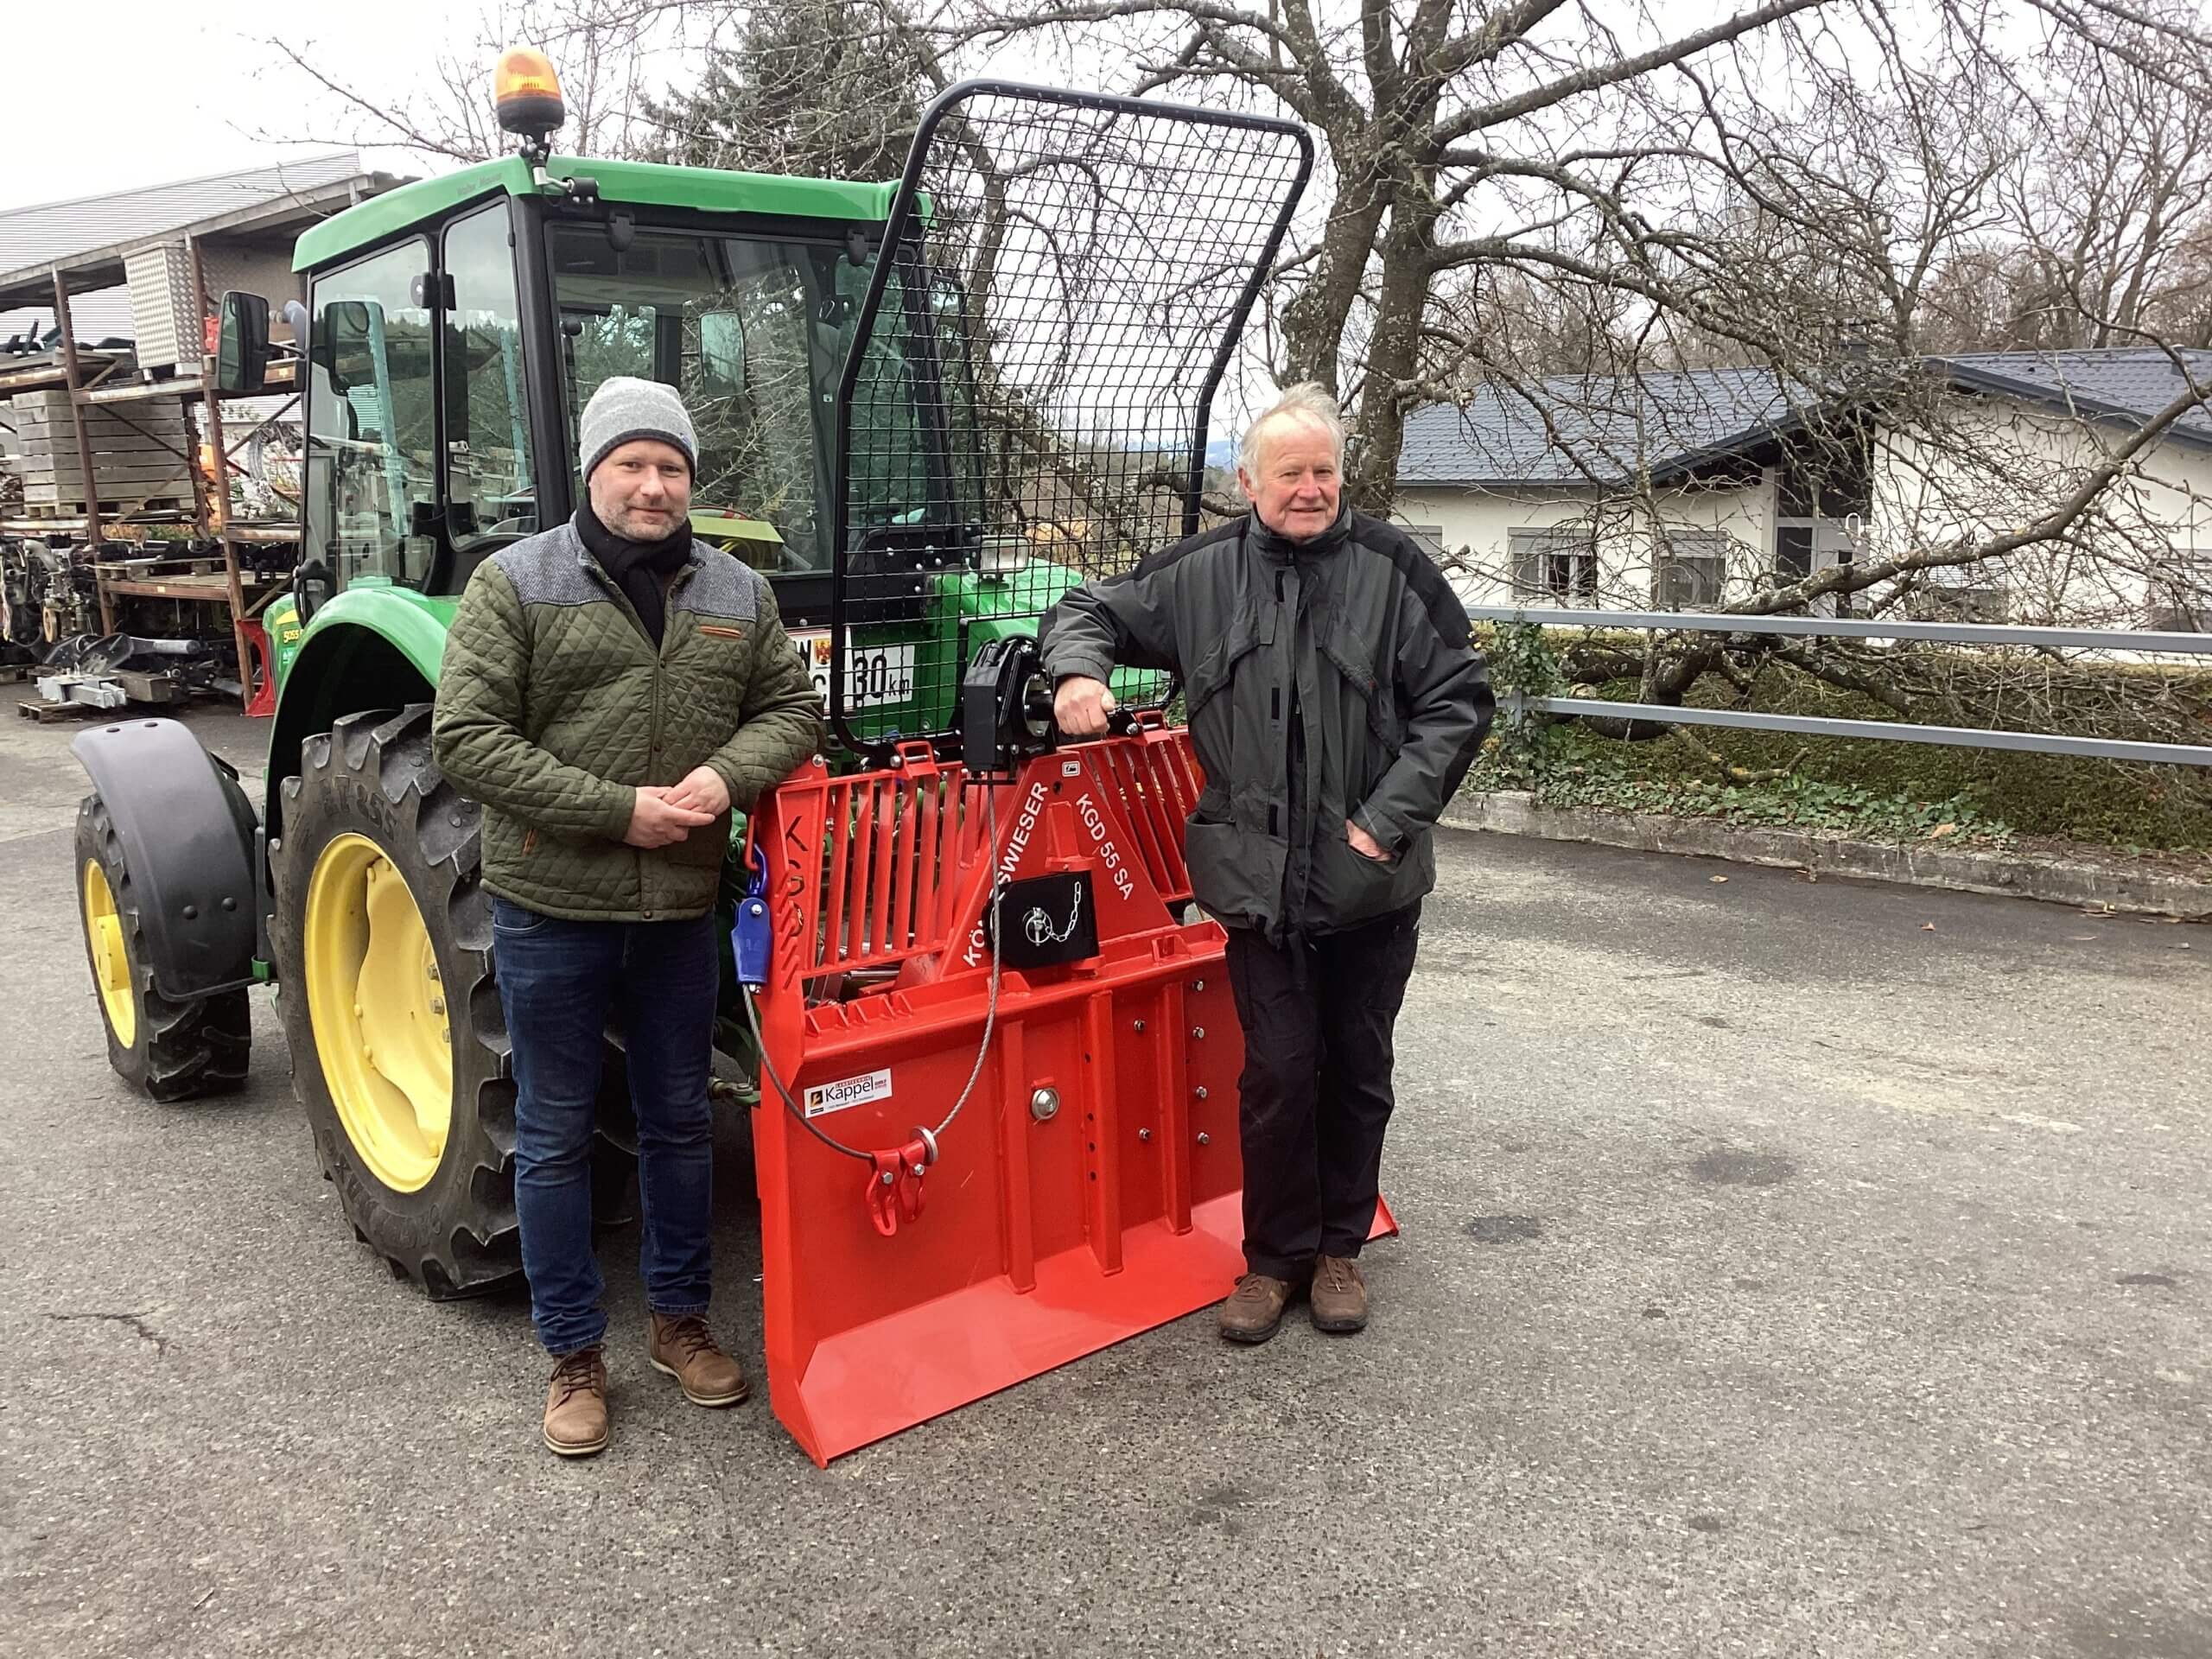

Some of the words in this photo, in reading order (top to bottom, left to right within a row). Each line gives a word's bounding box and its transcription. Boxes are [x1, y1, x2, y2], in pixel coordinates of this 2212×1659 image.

[855, 655, 887, 701] 30
[888, 673, 910, 697] km
[1076, 792, 1106, 842] KGD
[1100, 842, 1121, 869] 55
[1113, 868, 1135, 901] SA
[825, 1076, 874, 1103] Kappel
